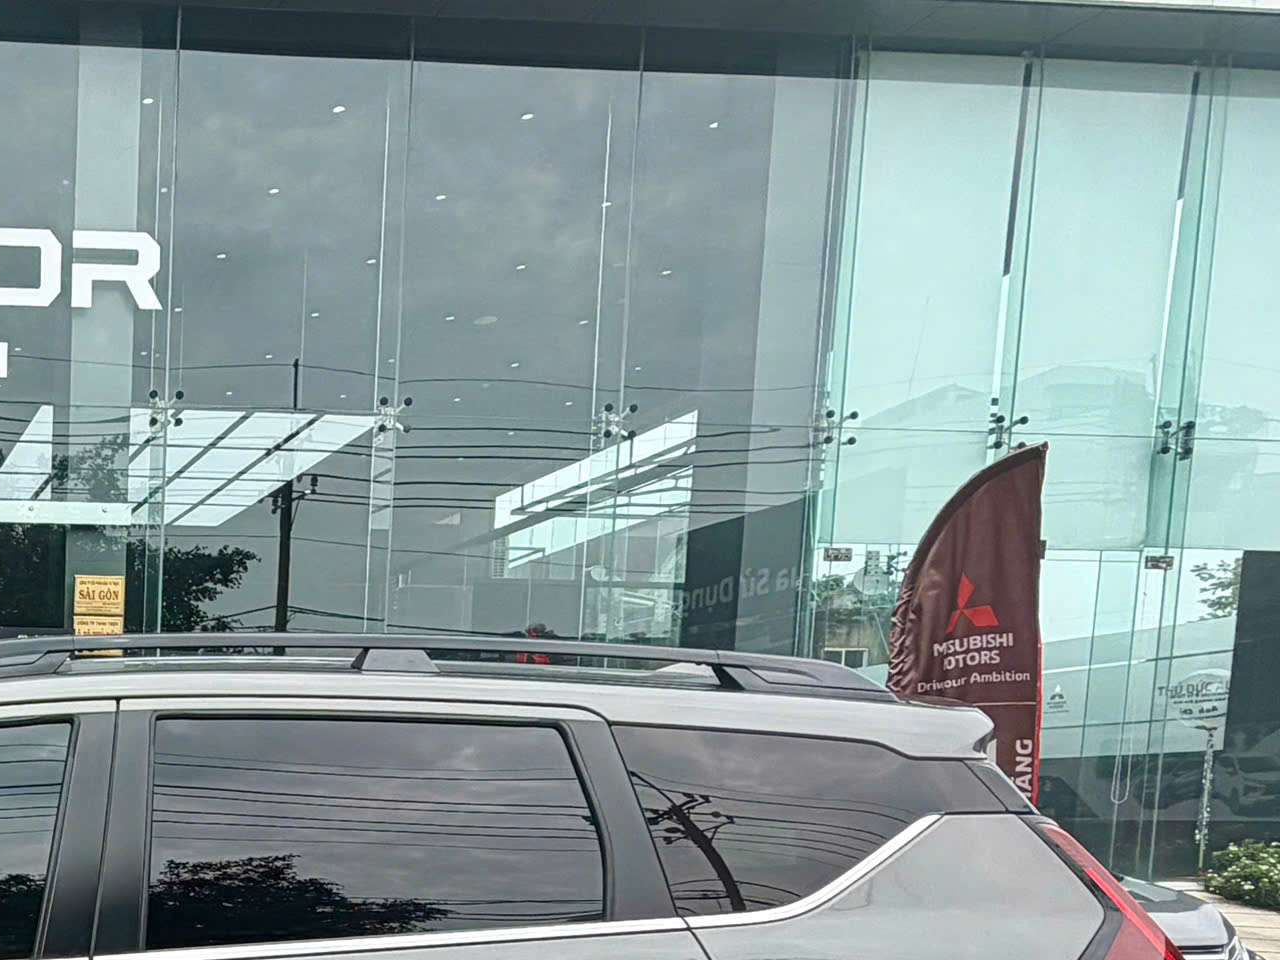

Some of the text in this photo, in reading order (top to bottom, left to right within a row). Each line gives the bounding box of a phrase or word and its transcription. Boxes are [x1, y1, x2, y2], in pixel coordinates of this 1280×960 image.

[98, 587, 120, 601] GÒN
[943, 650, 1001, 671] OTORS
[970, 670, 1031, 684] Ambition
